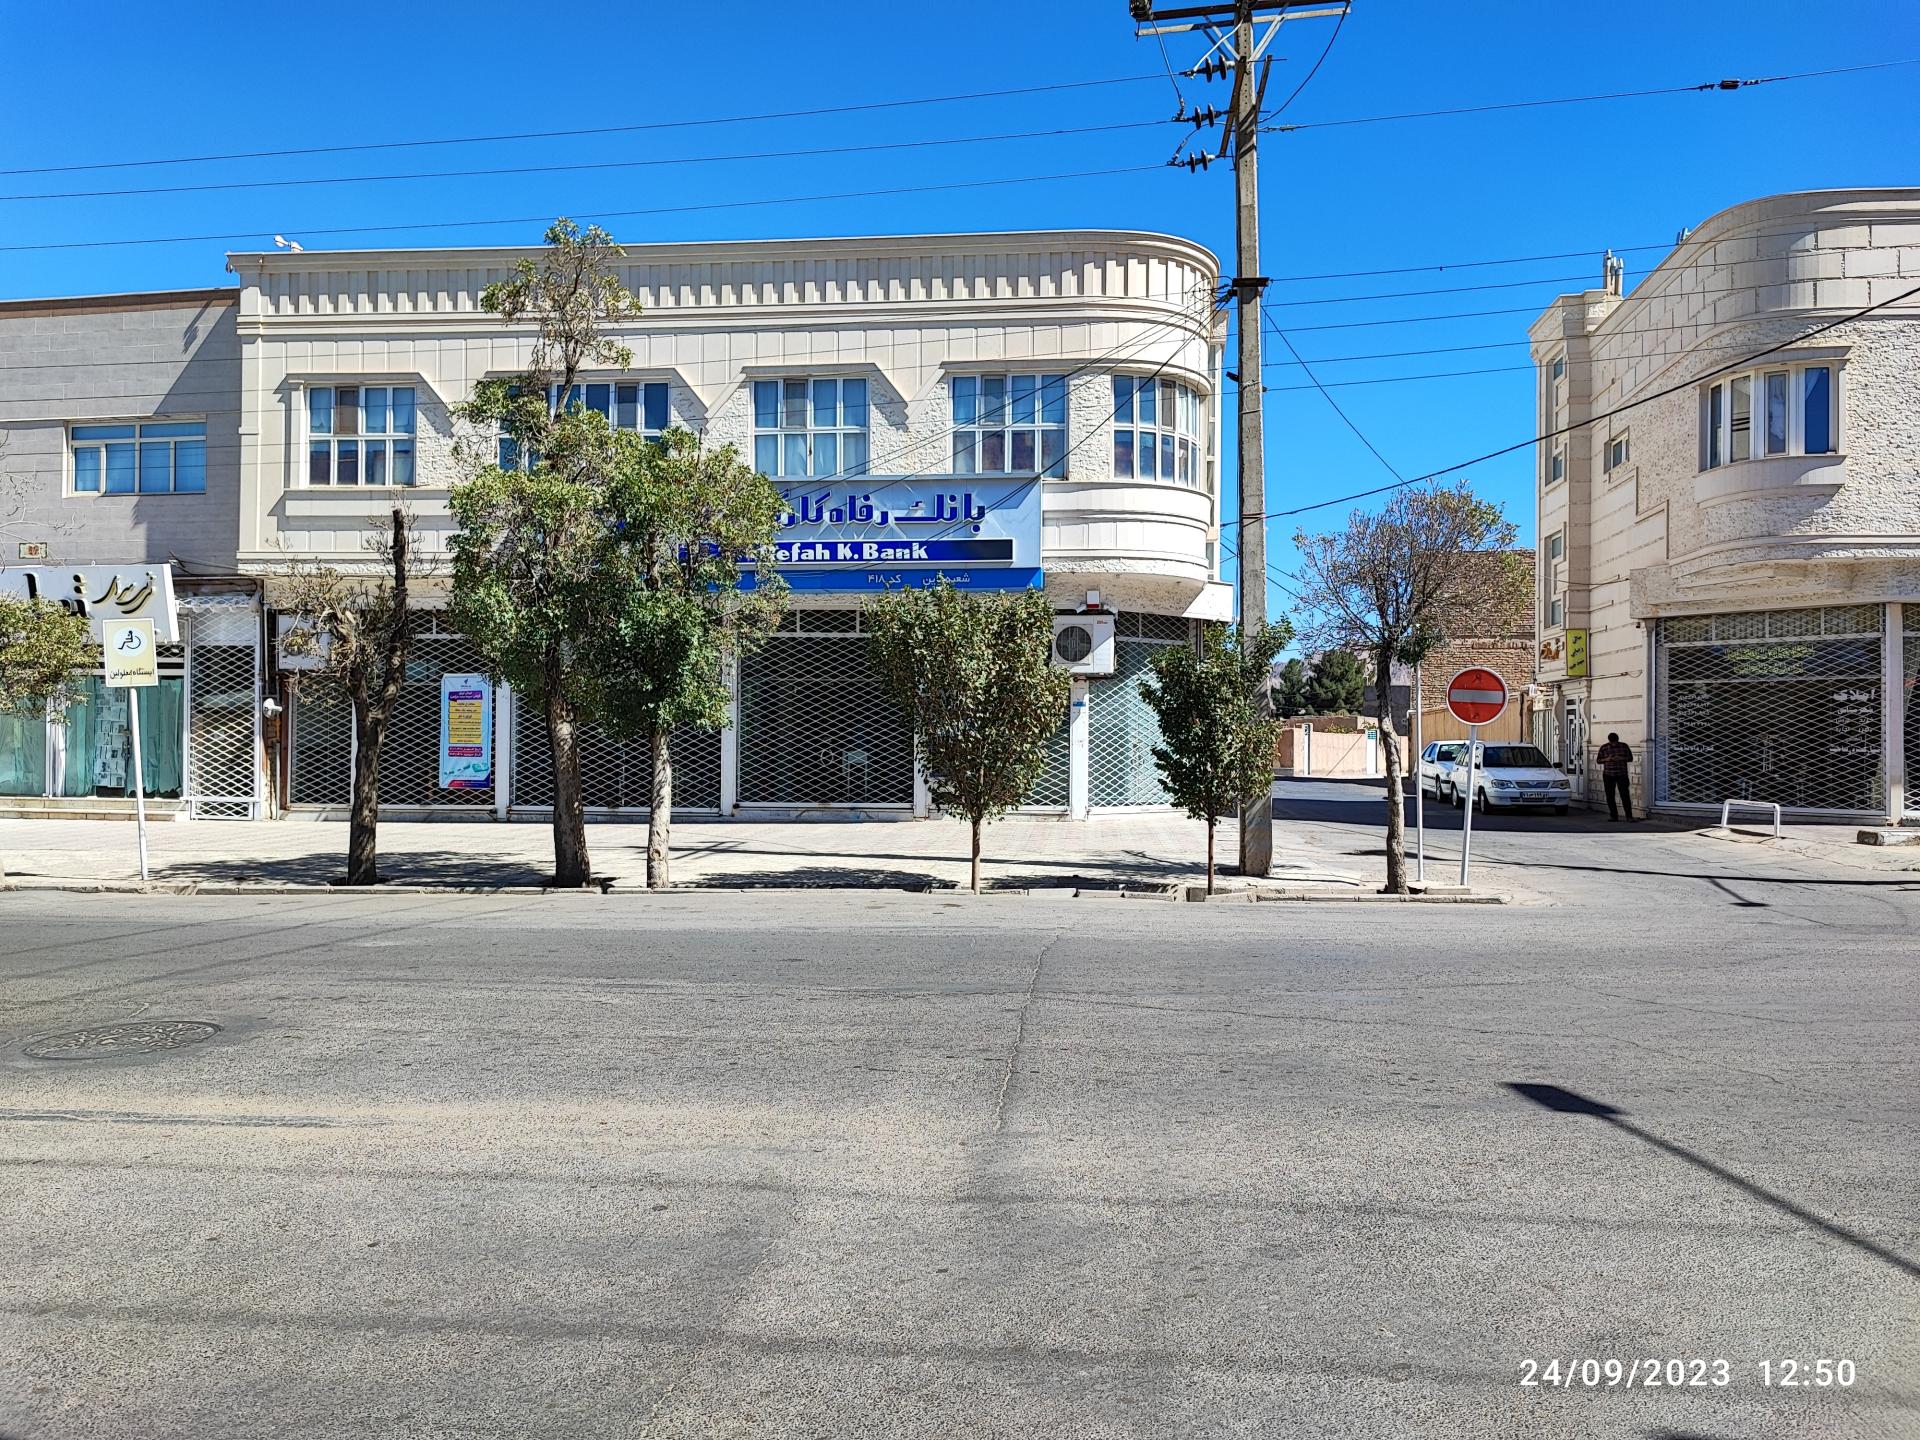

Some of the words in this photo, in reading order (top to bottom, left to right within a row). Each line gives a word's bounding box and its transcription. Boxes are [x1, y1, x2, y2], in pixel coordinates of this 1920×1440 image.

[828, 493, 889, 526] رفاه
[867, 574, 885, 583] ۴۱۸
[888, 574, 901, 583] کد
[109, 669, 132, 680] معلولین
[132, 667, 155, 676] ایستگاه
